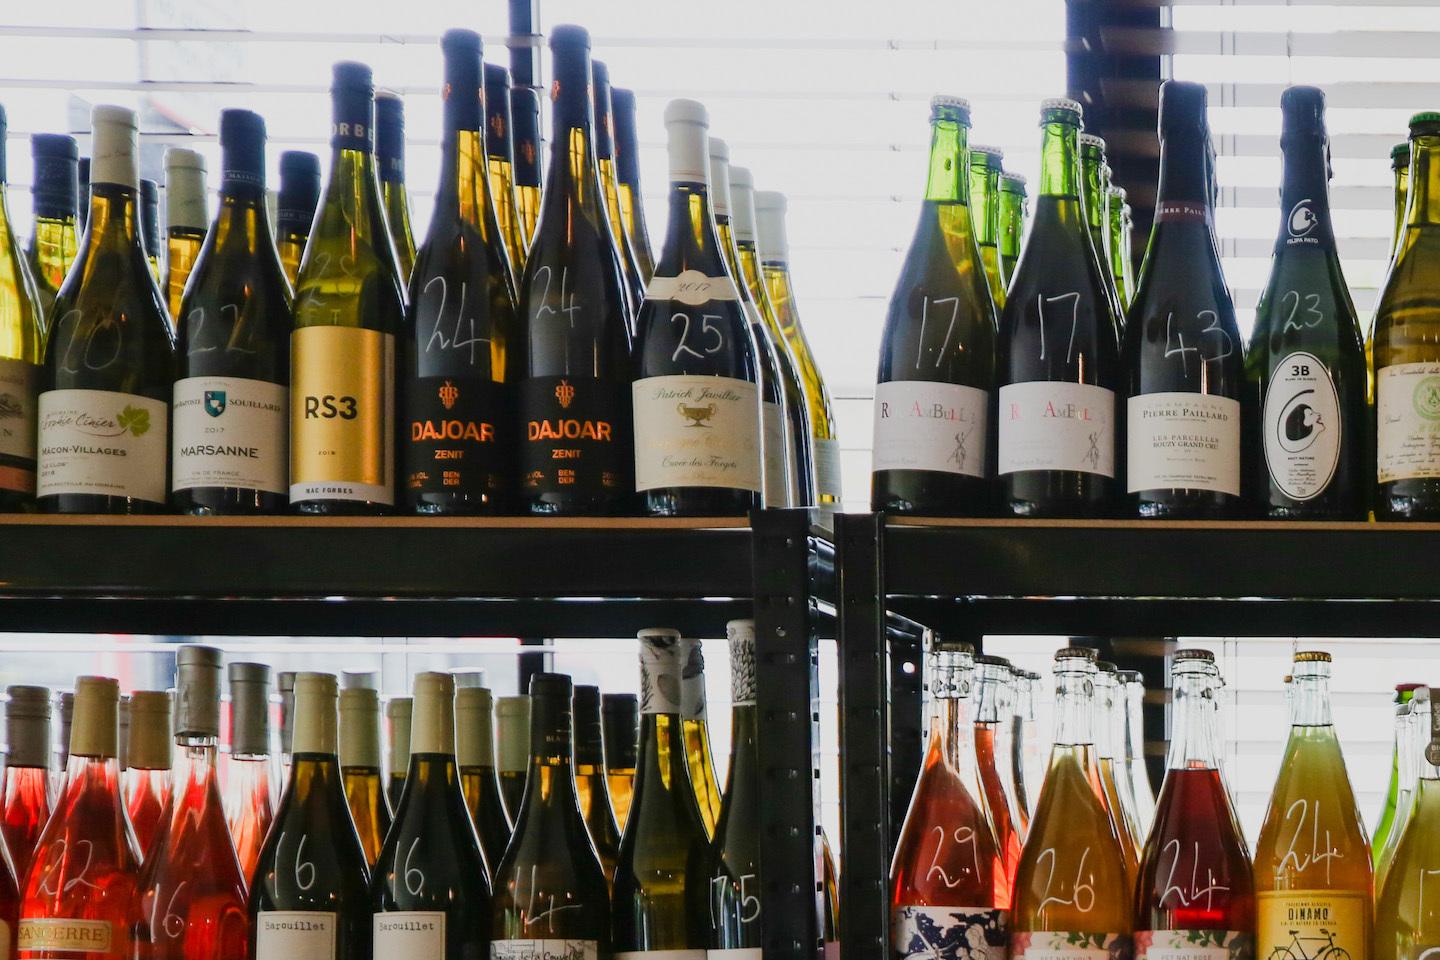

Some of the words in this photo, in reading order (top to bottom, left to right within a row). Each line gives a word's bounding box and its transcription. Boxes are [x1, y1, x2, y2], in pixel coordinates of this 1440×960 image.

[424, 275, 493, 366] 24
[533, 265, 582, 328] 24
[1282, 290, 1324, 334] 23
[59, 308, 122, 374] 20
[187, 303, 256, 356] 22
[671, 312, 723, 362] 25
[916, 294, 960, 370] 17
[1038, 292, 1081, 365] 17
[1164, 310, 1234, 379] 43
[1292, 365, 1310, 376] 3B
[304, 395, 358, 420] RS3
[411, 420, 496, 443] DAJOAR
[528, 420, 613, 442] DAJOAR
[1143, 410, 1178, 419] PIERRE
[1183, 408, 1229, 421] PAILLARD
[181, 446, 259, 459] MARSANNE
[434, 450, 465, 459] ZENIT
[552, 450, 583, 459] ZENIT
[35, 838, 102, 897] 22
[274, 831, 316, 899] 16
[392, 836, 425, 902] 16
[926, 825, 983, 889] 29
[1276, 798, 1345, 886] 24
[512, 864, 583, 934] 14
[1036, 847, 1096, 917] 26
[1158, 839, 1231, 913] 24
[150, 880, 188, 943] 16
[265, 921, 326, 931] Barouillet
[379, 921, 435, 931] Barouillet
[1288, 907, 1329, 921] DINAMO
